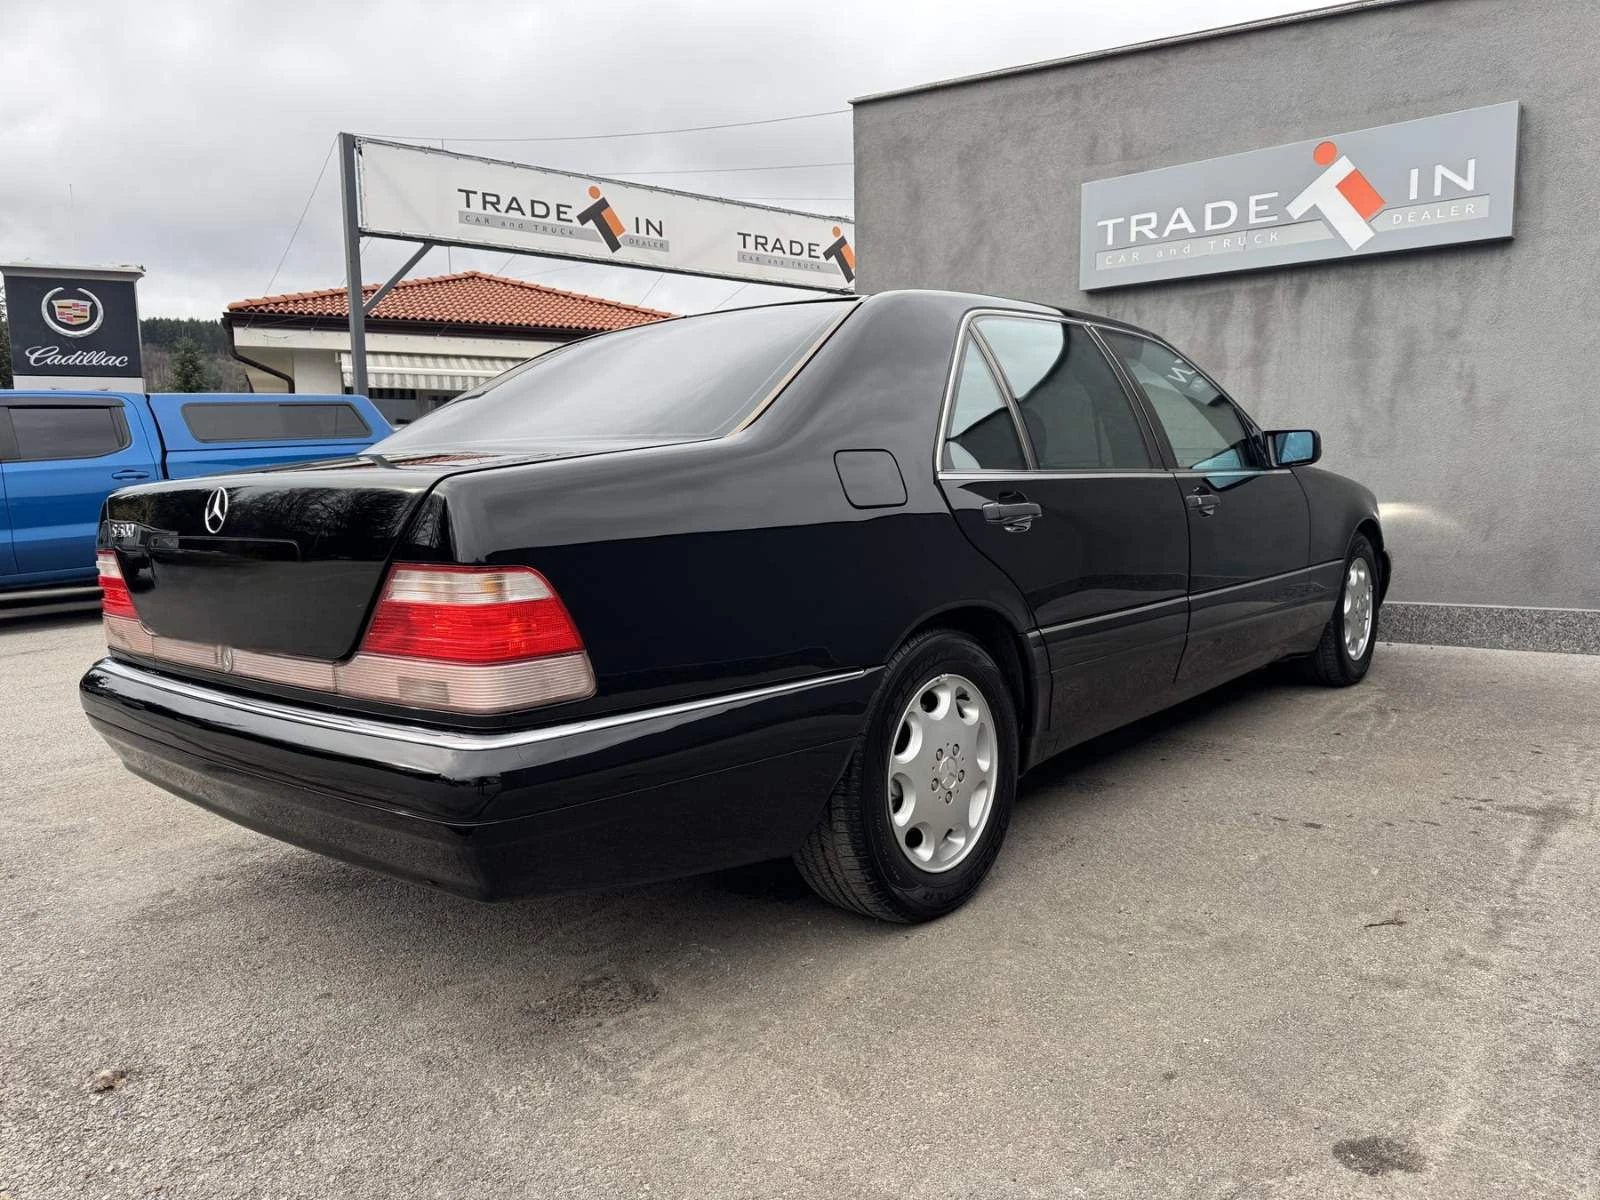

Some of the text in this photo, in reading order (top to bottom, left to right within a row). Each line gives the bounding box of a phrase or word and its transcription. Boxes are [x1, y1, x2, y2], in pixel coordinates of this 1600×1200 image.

[457, 188, 573, 223] TRADE
[635, 216, 663, 238] IN
[1096, 191, 1279, 246] TRADE
[1409, 158, 1477, 201] IN
[1392, 203, 1476, 225] DEALER
[464, 214, 575, 236] CAR and TRUCK
[628, 238, 665, 249] DEALER
[736, 232, 820, 259] TRADE
[1105, 231, 1279, 265] CAR and TRUCK
[24, 345, 129, 368] Cadillac
